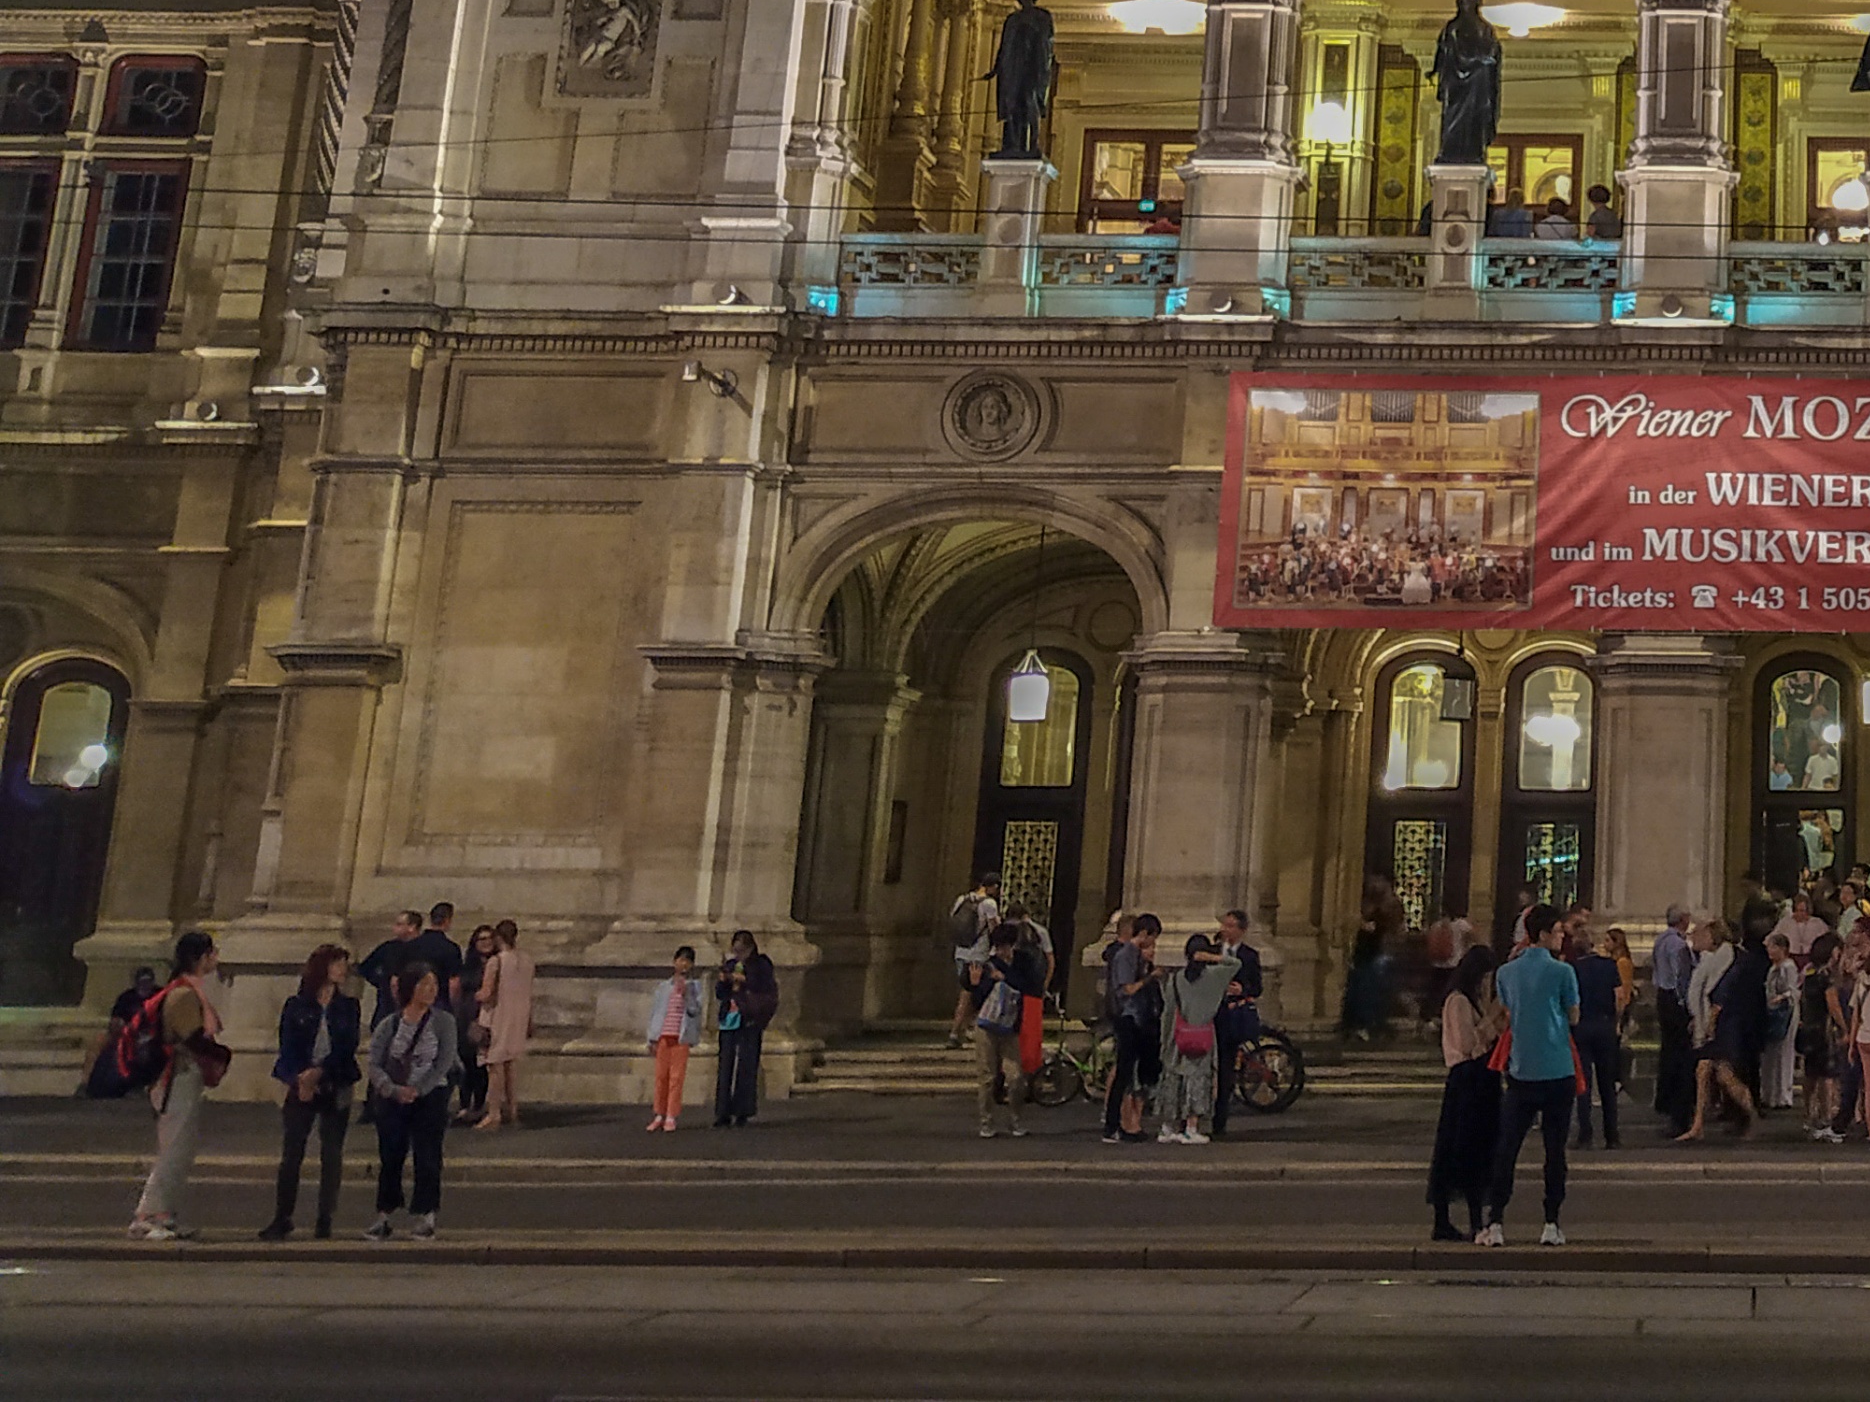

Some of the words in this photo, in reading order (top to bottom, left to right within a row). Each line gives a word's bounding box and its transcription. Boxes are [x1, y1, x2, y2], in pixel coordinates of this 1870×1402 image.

[1560, 393, 1733, 438] Wiener
[1628, 485, 1651, 505] in
[1659, 484, 1697, 505] der
[1550, 541, 1595, 562] und
[1603, 542, 1634, 562] im
[1570, 584, 1676, 609] Tickets:
[1731, 586, 1785, 610] +43
[1797, 587, 1811, 610] 1
